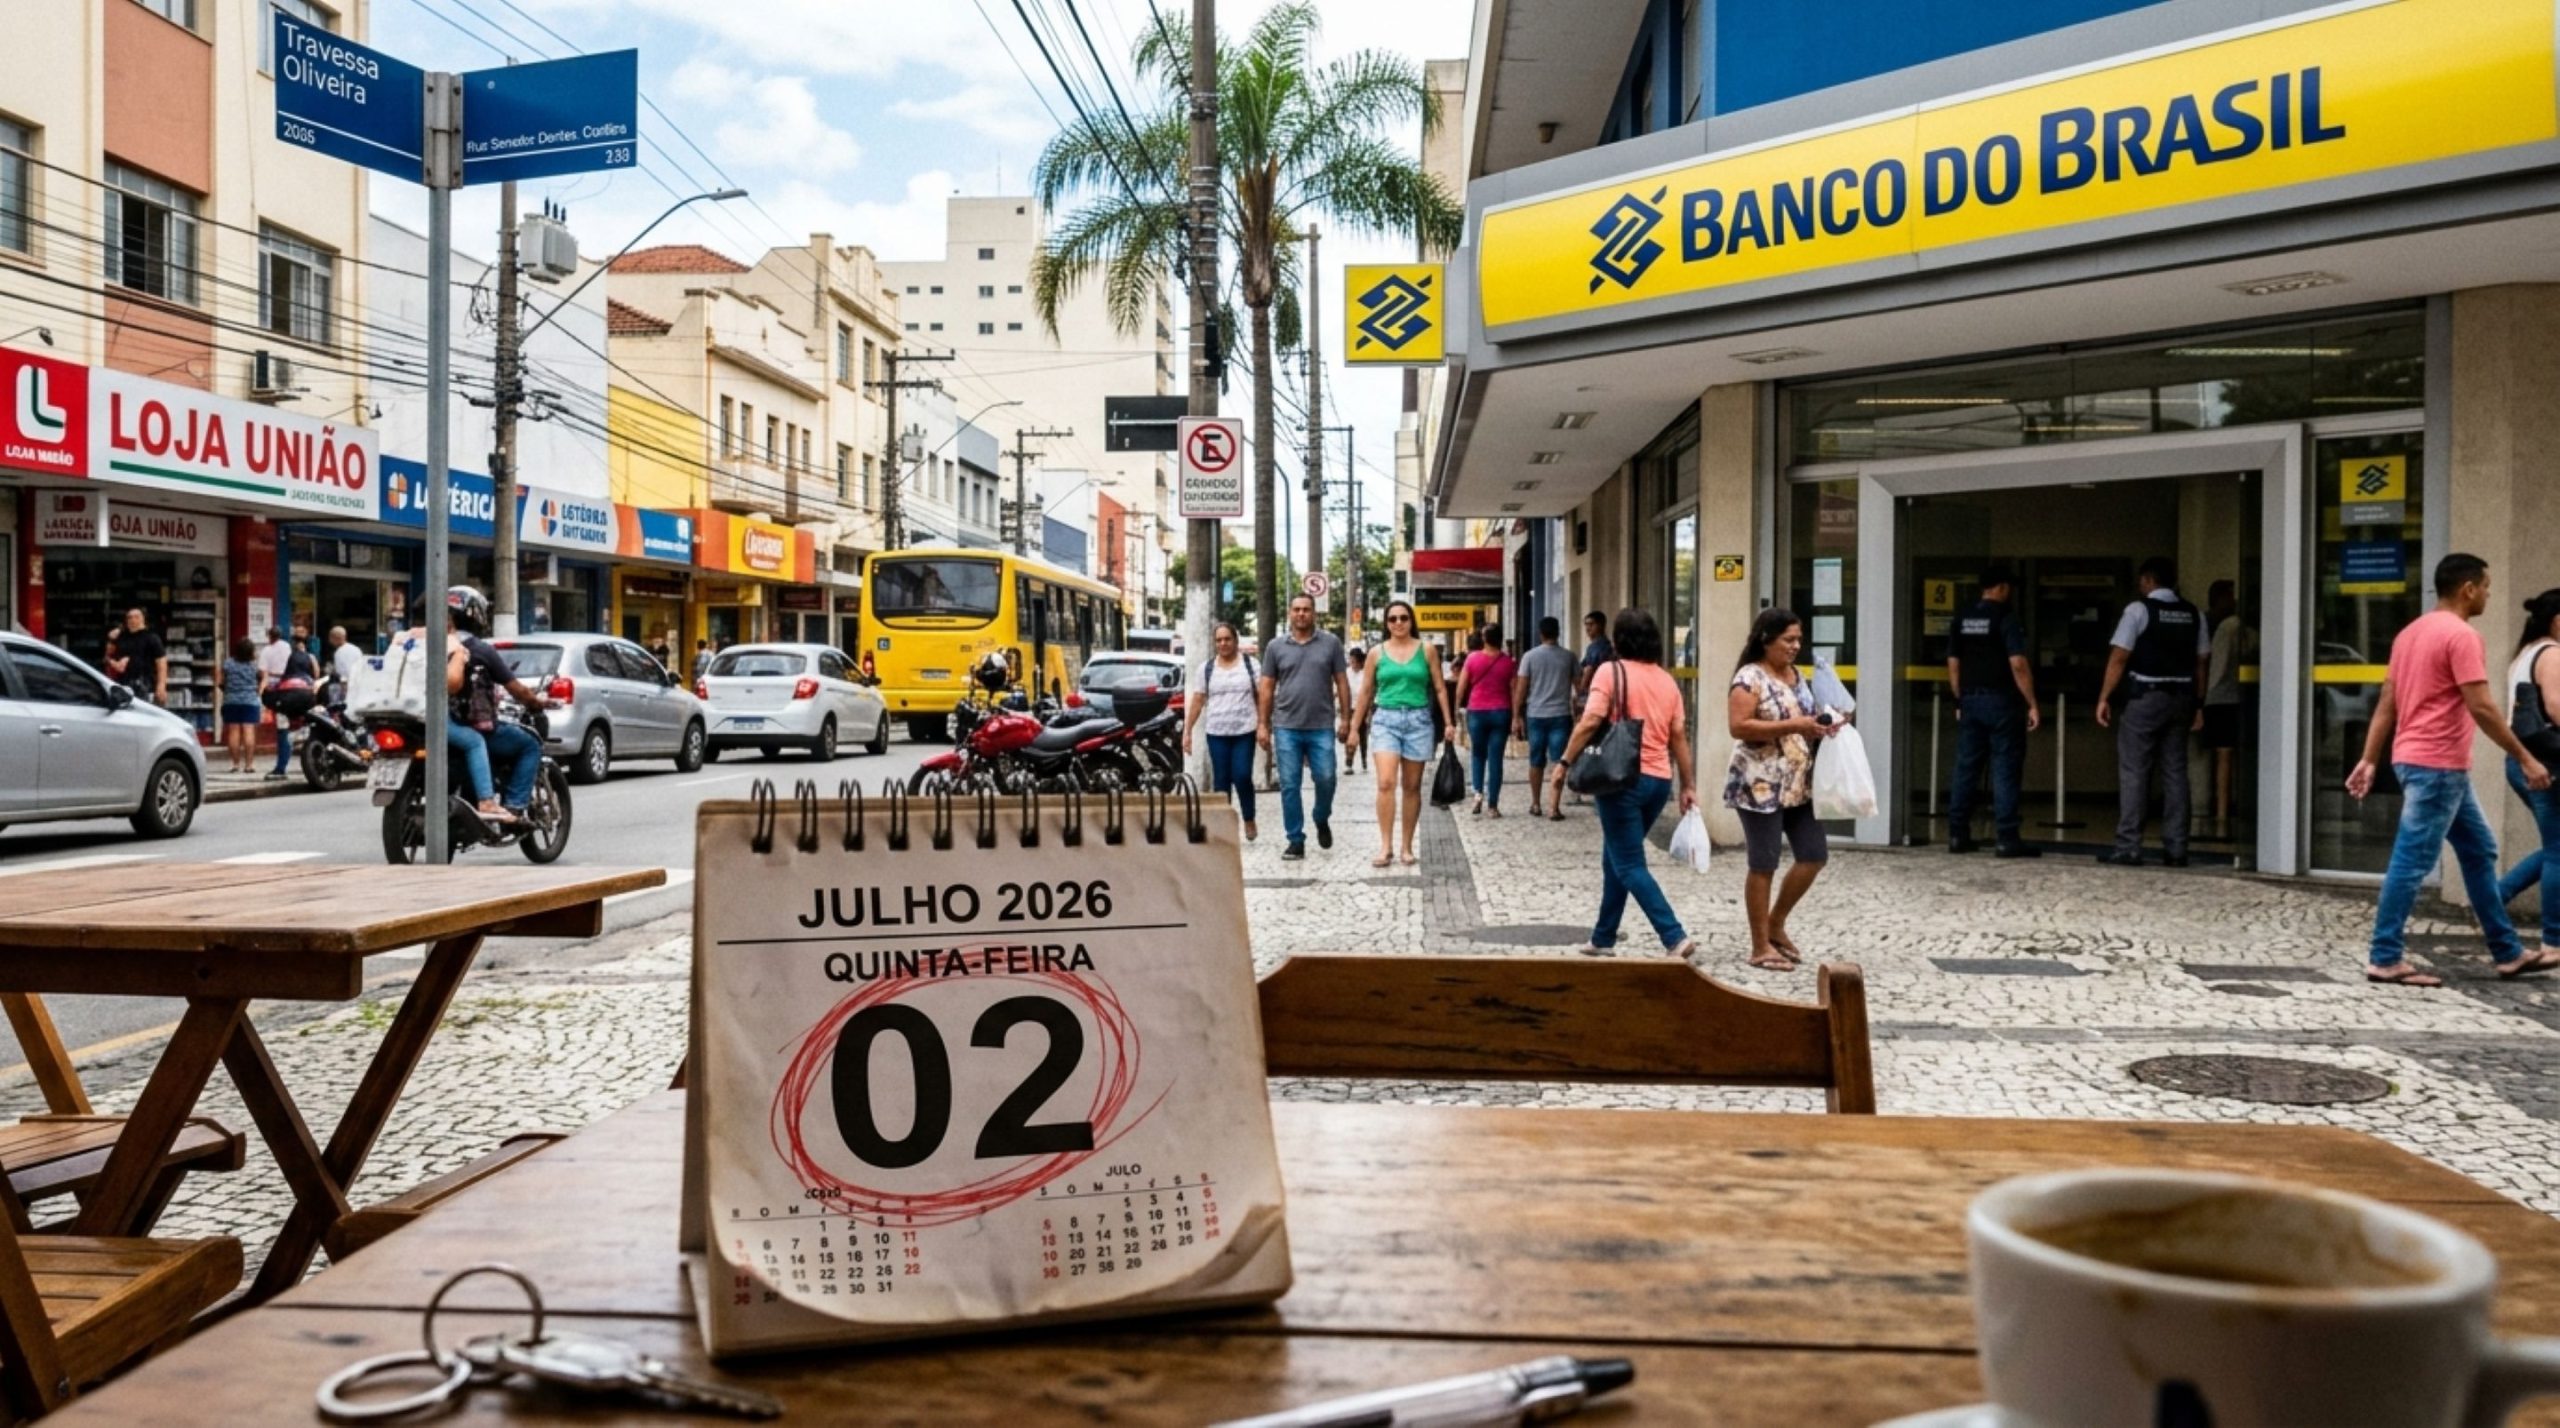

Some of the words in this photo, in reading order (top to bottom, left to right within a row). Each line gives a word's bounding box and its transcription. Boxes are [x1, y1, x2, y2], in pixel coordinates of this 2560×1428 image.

[282, 21, 380, 80] Travessa
[283, 54, 367, 105] Oliveira
[1681, 157, 1907, 264] BANCO
[1924, 134, 2022, 216] DO
[2039, 65, 2347, 194] BRASIL
[110, 392, 230, 468] LOJA
[246, 425, 367, 491] UNIÃO
[413, 480, 495, 522] LTÉRIC
[799, 884, 981, 929] JULHO
[997, 880, 1113, 920] 2026
[824, 943, 1095, 983] QUINTA-FEIRA
[831, 994, 1095, 1169] 02
[1105, 1163, 1142, 1178] JULO
[1097, 1213, 1106, 1225] 7
[1174, 1205, 1189, 1218] 11
[820, 1220, 827, 1232] 1
[847, 1219, 857, 1231] 2
[1096, 1229, 1112, 1242] 14
[1149, 1223, 1166, 1236] 17
[792, 1238, 800, 1250] 7
[874, 1232, 890, 1245] 10
[902, 1231, 917, 1243] 11
[875, 1248, 890, 1261] 17
[1096, 1245, 1112, 1258] 21
[819, 1269, 836, 1281] 22
[847, 1267, 864, 1280] 22
[1071, 1263, 1087, 1276] 27
[877, 1281, 893, 1293] 31
